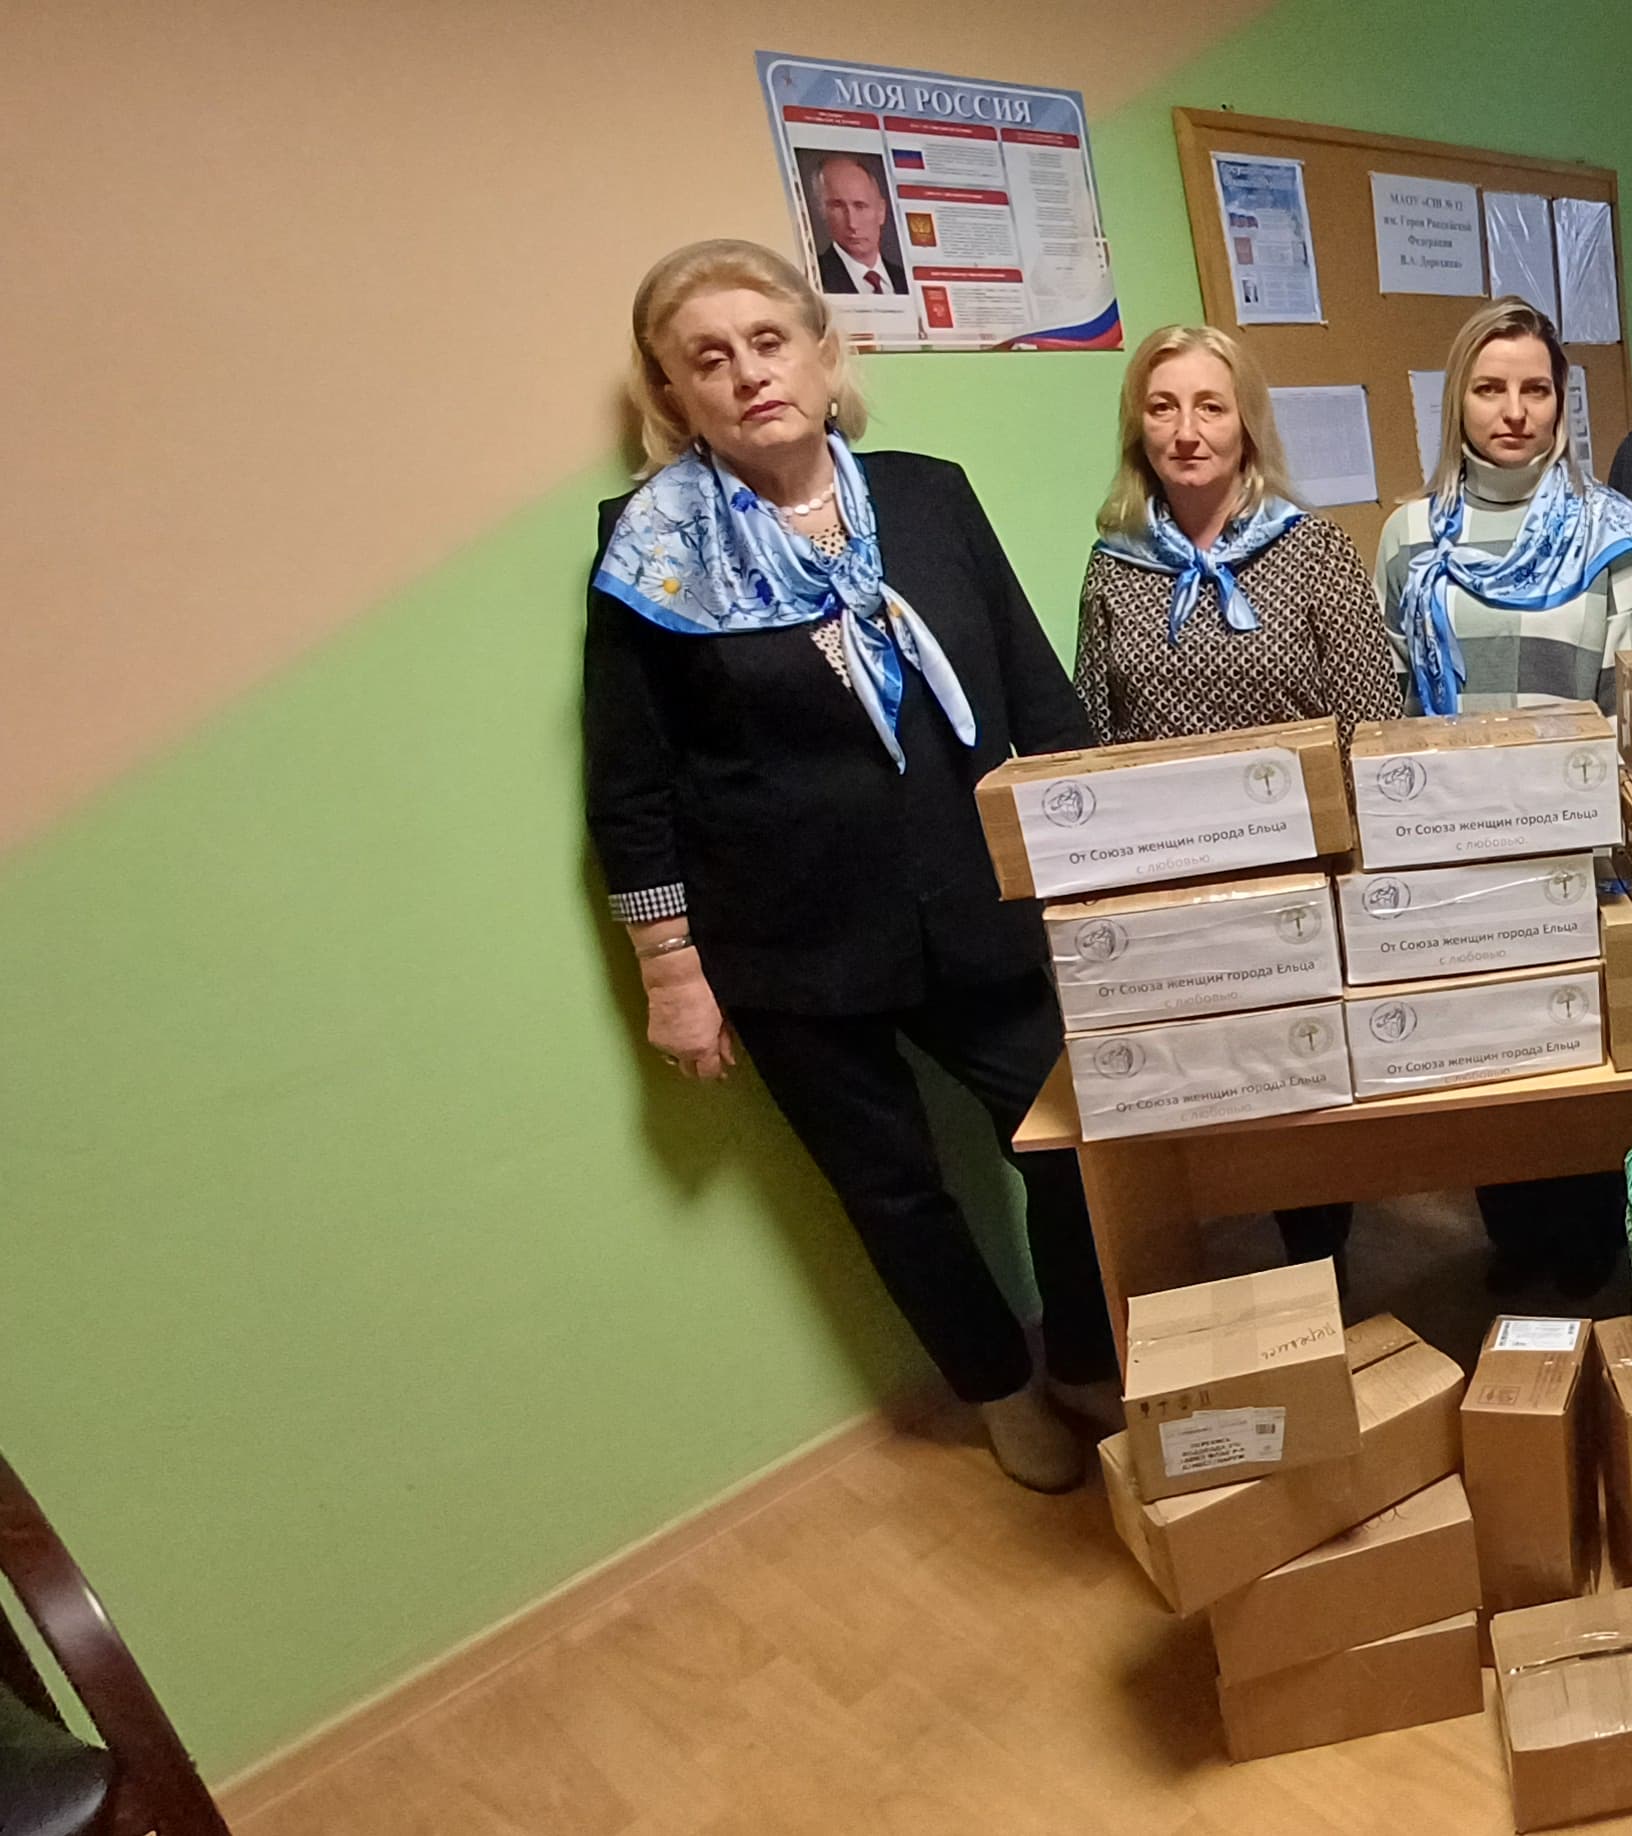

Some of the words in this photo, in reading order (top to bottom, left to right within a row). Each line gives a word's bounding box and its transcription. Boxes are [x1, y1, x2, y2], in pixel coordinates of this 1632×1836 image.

[833, 78, 906, 112] МОЯ
[914, 87, 1032, 124] РОССИЯ
[1396, 825, 1412, 837] От
[1415, 822, 1456, 835] Союза
[1459, 818, 1513, 832] женщин
[1515, 812, 1559, 827] города
[1562, 808, 1599, 822] Ельца
[1069, 852, 1086, 865] От
[1090, 846, 1134, 861] Союза
[1138, 837, 1195, 852] женщин
[1198, 827, 1245, 844] города
[1248, 820, 1287, 836] Ельца
[1380, 942, 1396, 954] От
[1400, 938, 1440, 952] Союза
[1443, 933, 1494, 946] женщин
[1497, 926, 1540, 941] города
[1543, 921, 1579, 935] Ельца
[1098, 986, 1116, 998] От
[1120, 981, 1163, 996] Союза
[1167, 973, 1224, 988] женщин
[1226, 967, 1273, 982] города
[1276, 960, 1315, 975] Ельца
[1387, 1064, 1403, 1075] От
[1406, 1060, 1445, 1073] Союза
[1448, 1053, 1498, 1068] женщин
[1501, 1046, 1543, 1059] города
[1546, 1039, 1581, 1053] Ельца
[1116, 1102, 1133, 1113] От
[1137, 1095, 1179, 1110] Союза
[1183, 1087, 1238, 1102] женщин
[1241, 1080, 1286, 1095] города
[1289, 1073, 1327, 1087] Ельца
